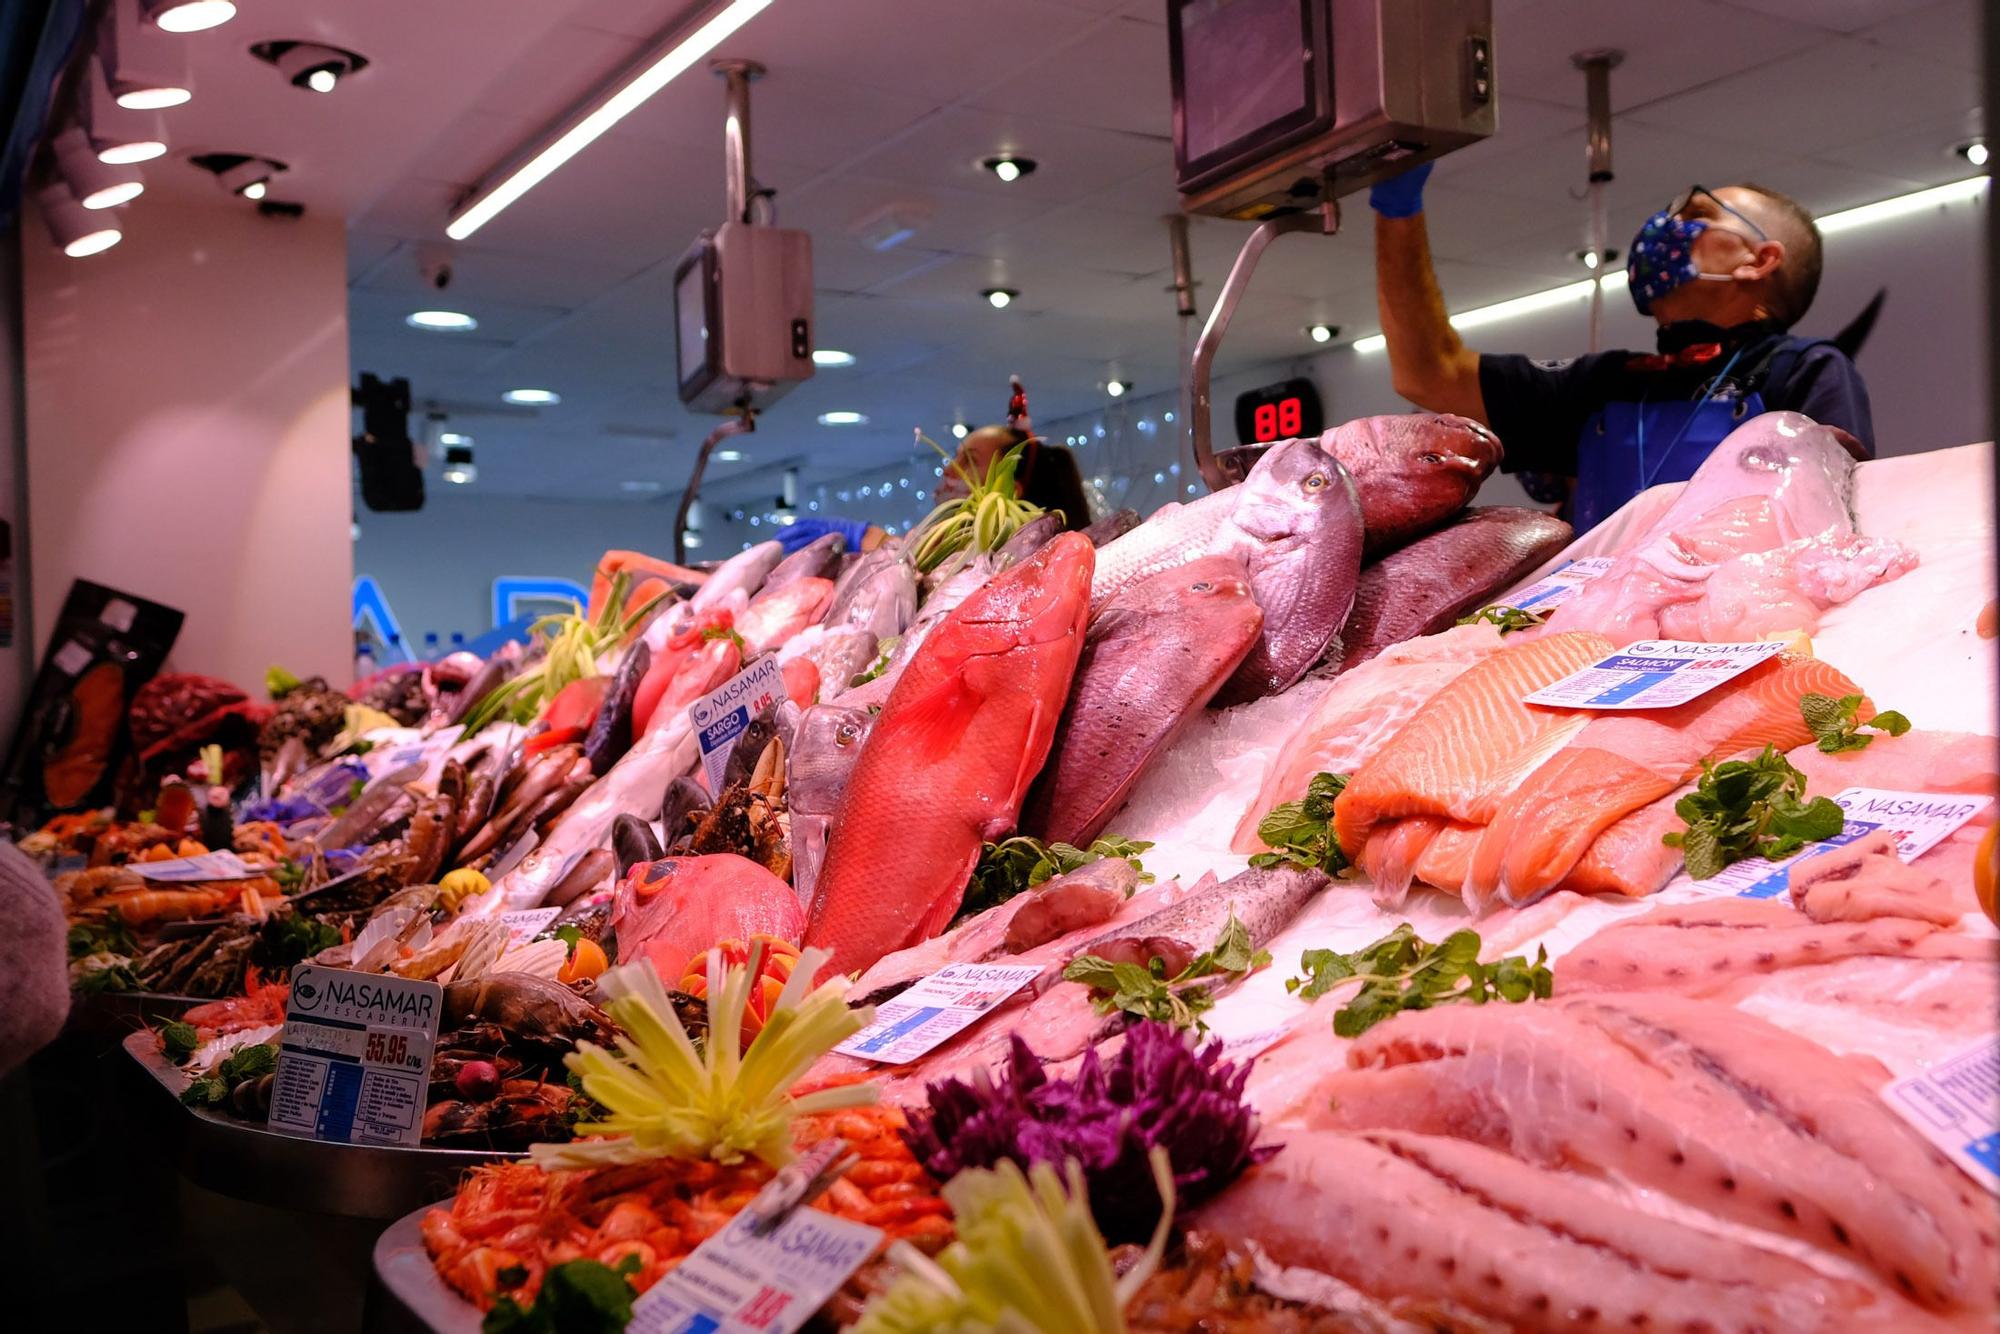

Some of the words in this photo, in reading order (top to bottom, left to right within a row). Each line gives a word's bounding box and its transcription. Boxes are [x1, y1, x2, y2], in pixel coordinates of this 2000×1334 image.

[1255, 397, 1301, 442] 88
[1662, 642, 1785, 655] NASAMAR
[712, 660, 776, 711] NASAMAR
[706, 712, 740, 741] SARGO
[1859, 797, 1976, 820] NASAMAR
[958, 968, 1037, 982] NASAMAR
[327, 980, 433, 1018] NASAMAR
[366, 1033, 408, 1065] 55,95
